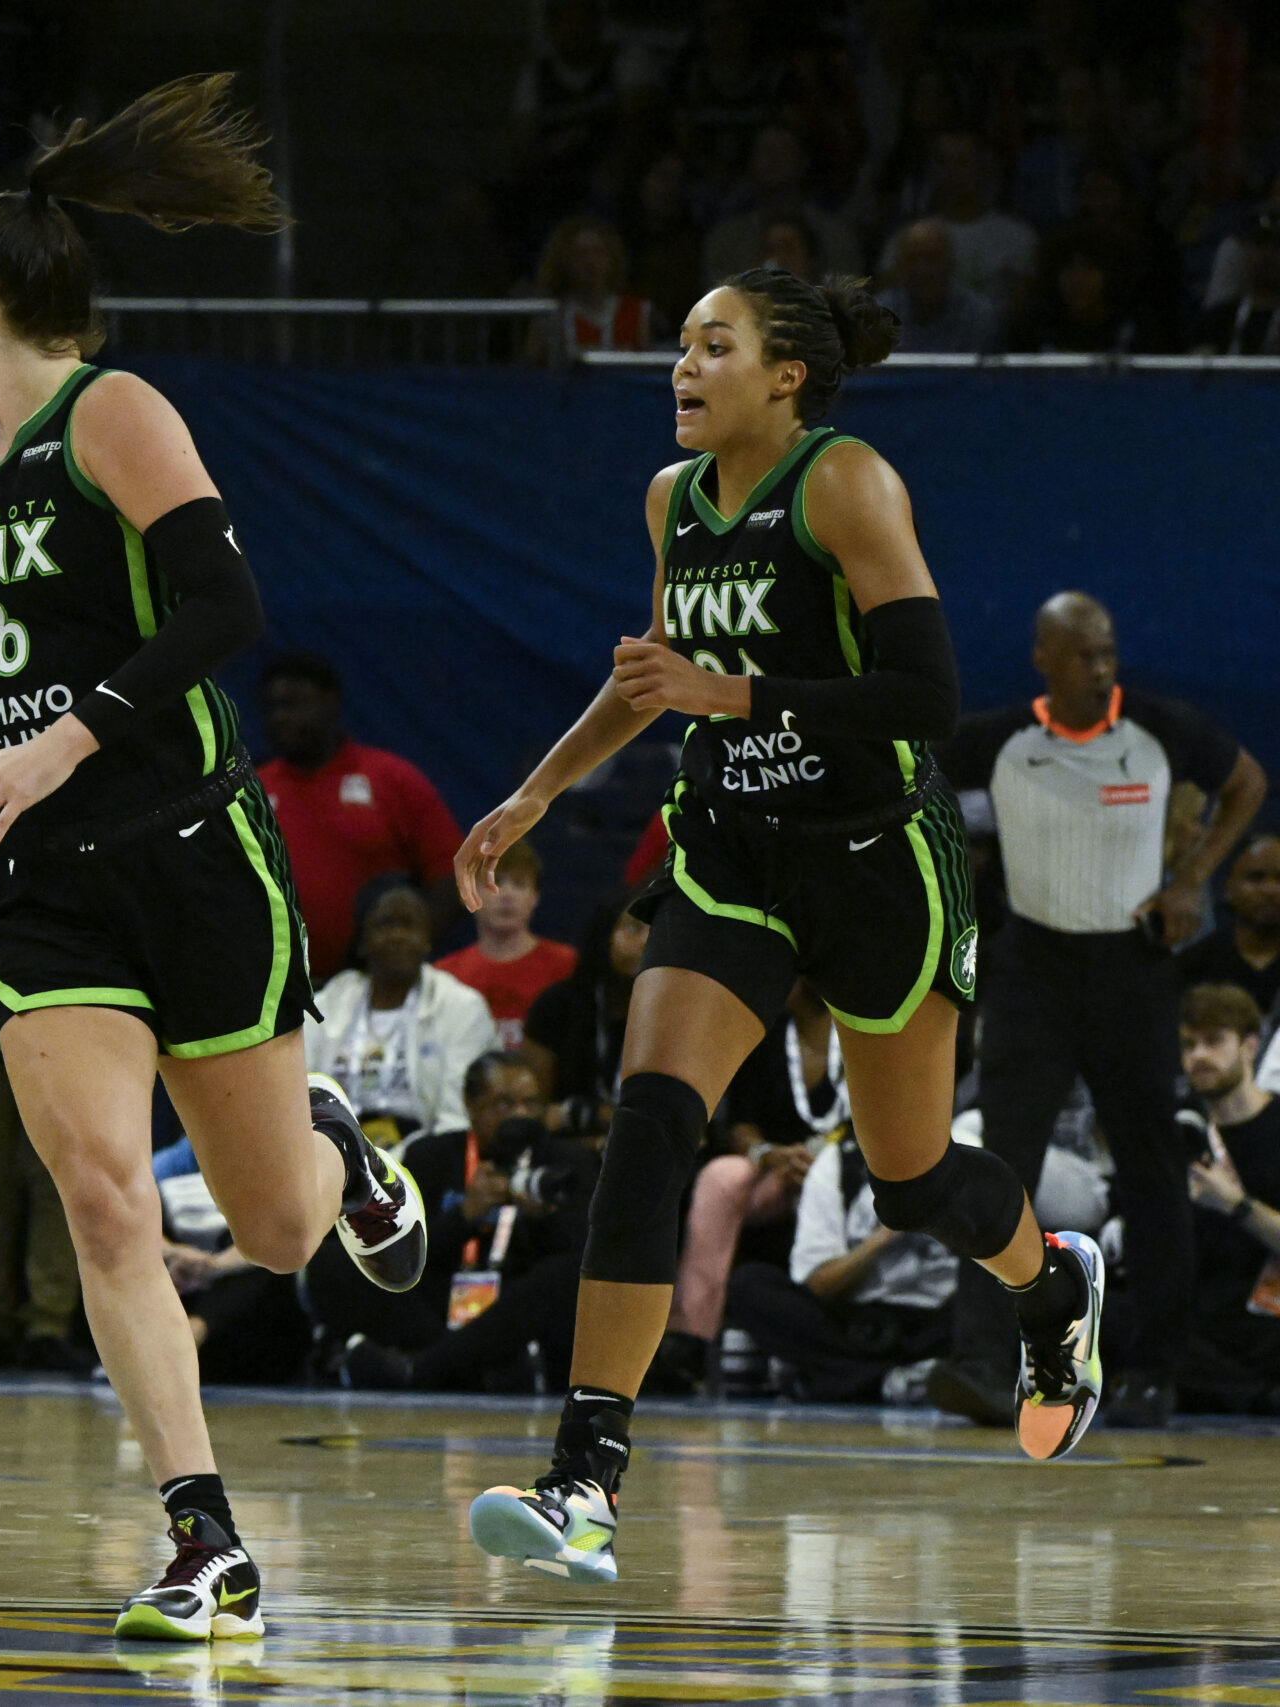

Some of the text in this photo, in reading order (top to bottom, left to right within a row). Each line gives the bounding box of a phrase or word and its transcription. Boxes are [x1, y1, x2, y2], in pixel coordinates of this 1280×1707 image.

[668, 561, 777, 581] INNESOTA
[663, 578, 781, 639] LYNX
[722, 731, 802, 763] MAYO
[722, 755, 825, 792] CLINIC
